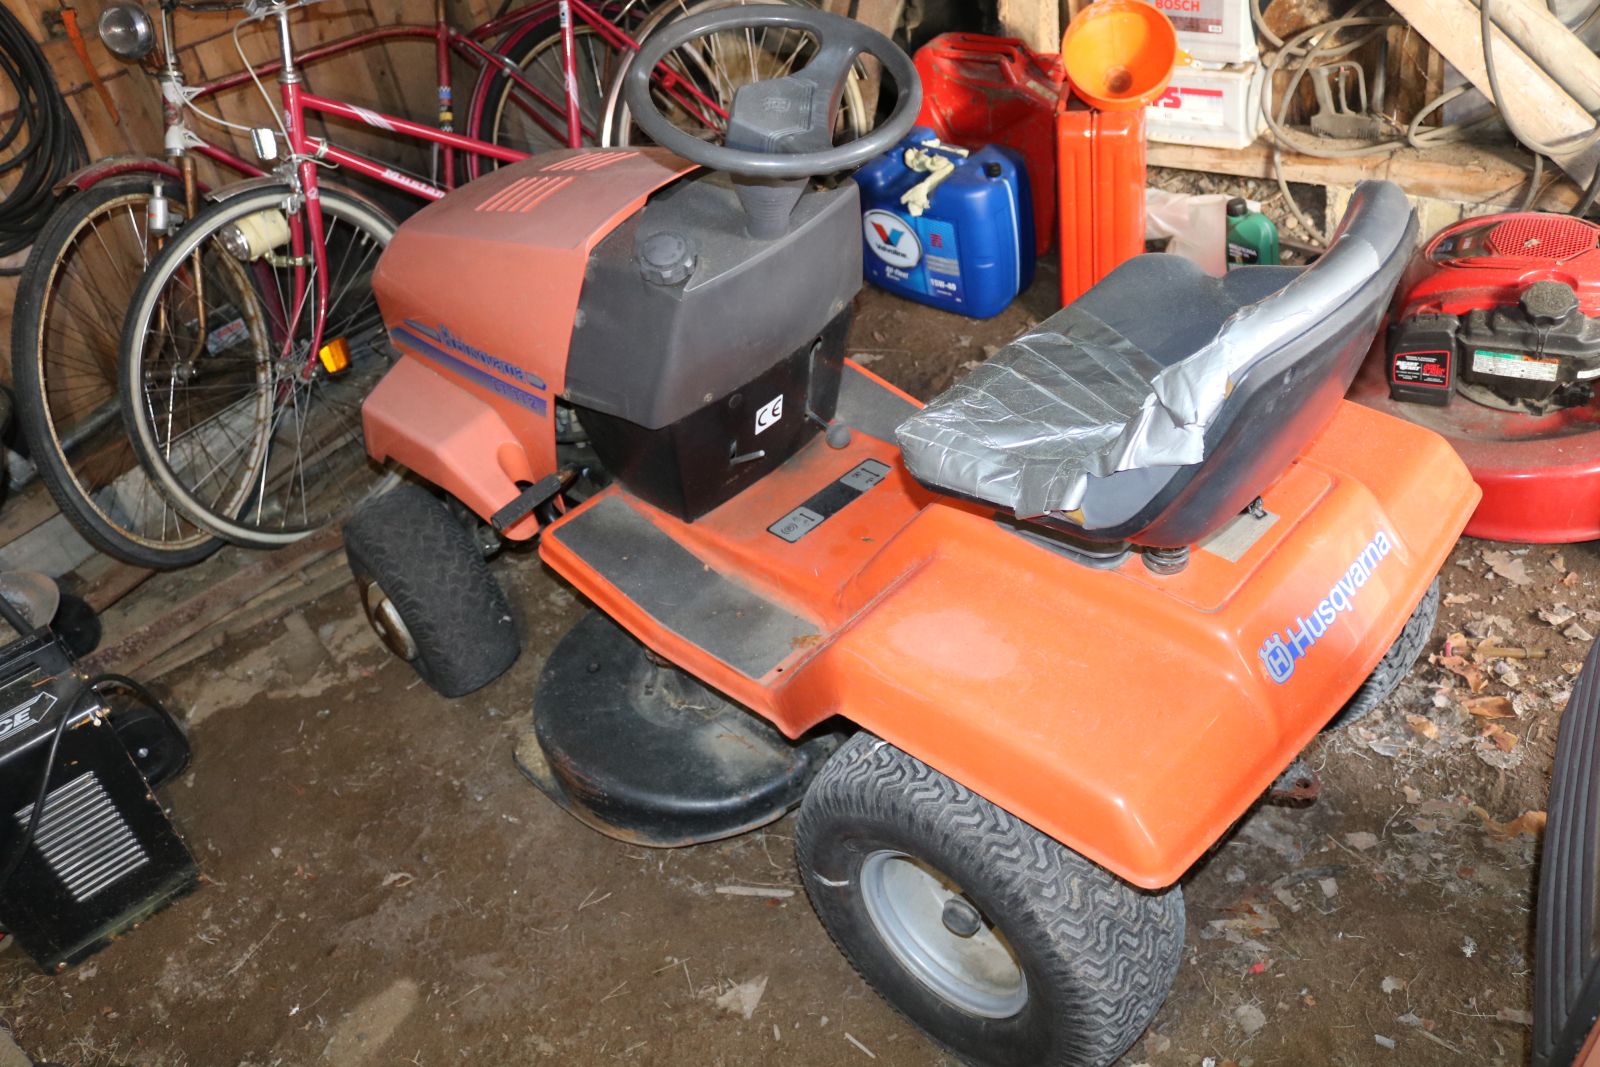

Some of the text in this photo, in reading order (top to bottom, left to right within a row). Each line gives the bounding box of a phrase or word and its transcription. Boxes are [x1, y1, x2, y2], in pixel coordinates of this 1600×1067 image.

[1154, 0, 1200, 12] BOSCH
[757, 398, 782, 427] CE
[1286, 529, 1392, 658] Husqvarna
